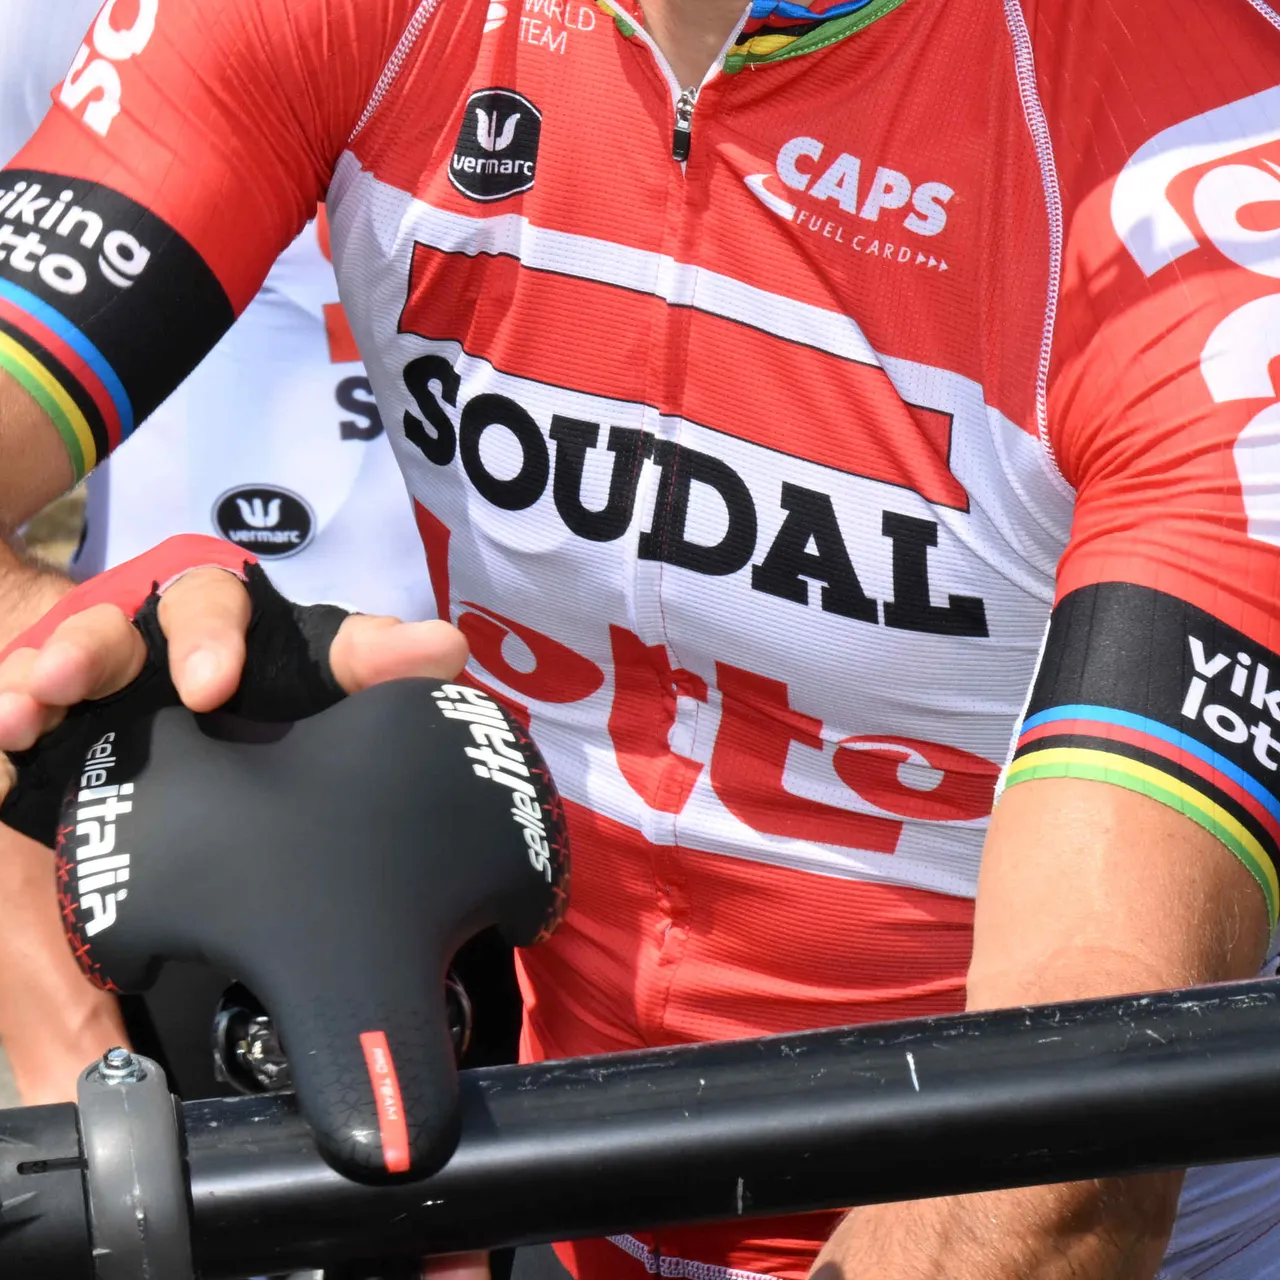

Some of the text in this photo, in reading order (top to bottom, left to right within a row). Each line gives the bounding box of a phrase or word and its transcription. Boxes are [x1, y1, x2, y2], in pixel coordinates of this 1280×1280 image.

[520, 17, 568, 55] TEAM
[452, 153, 534, 176] vermarc
[775, 135, 956, 237] CAPS
[797, 210, 912, 263] FUEL CARD
[402, 354, 990, 638] SOUDAL
[227, 529, 302, 544] vermarc
